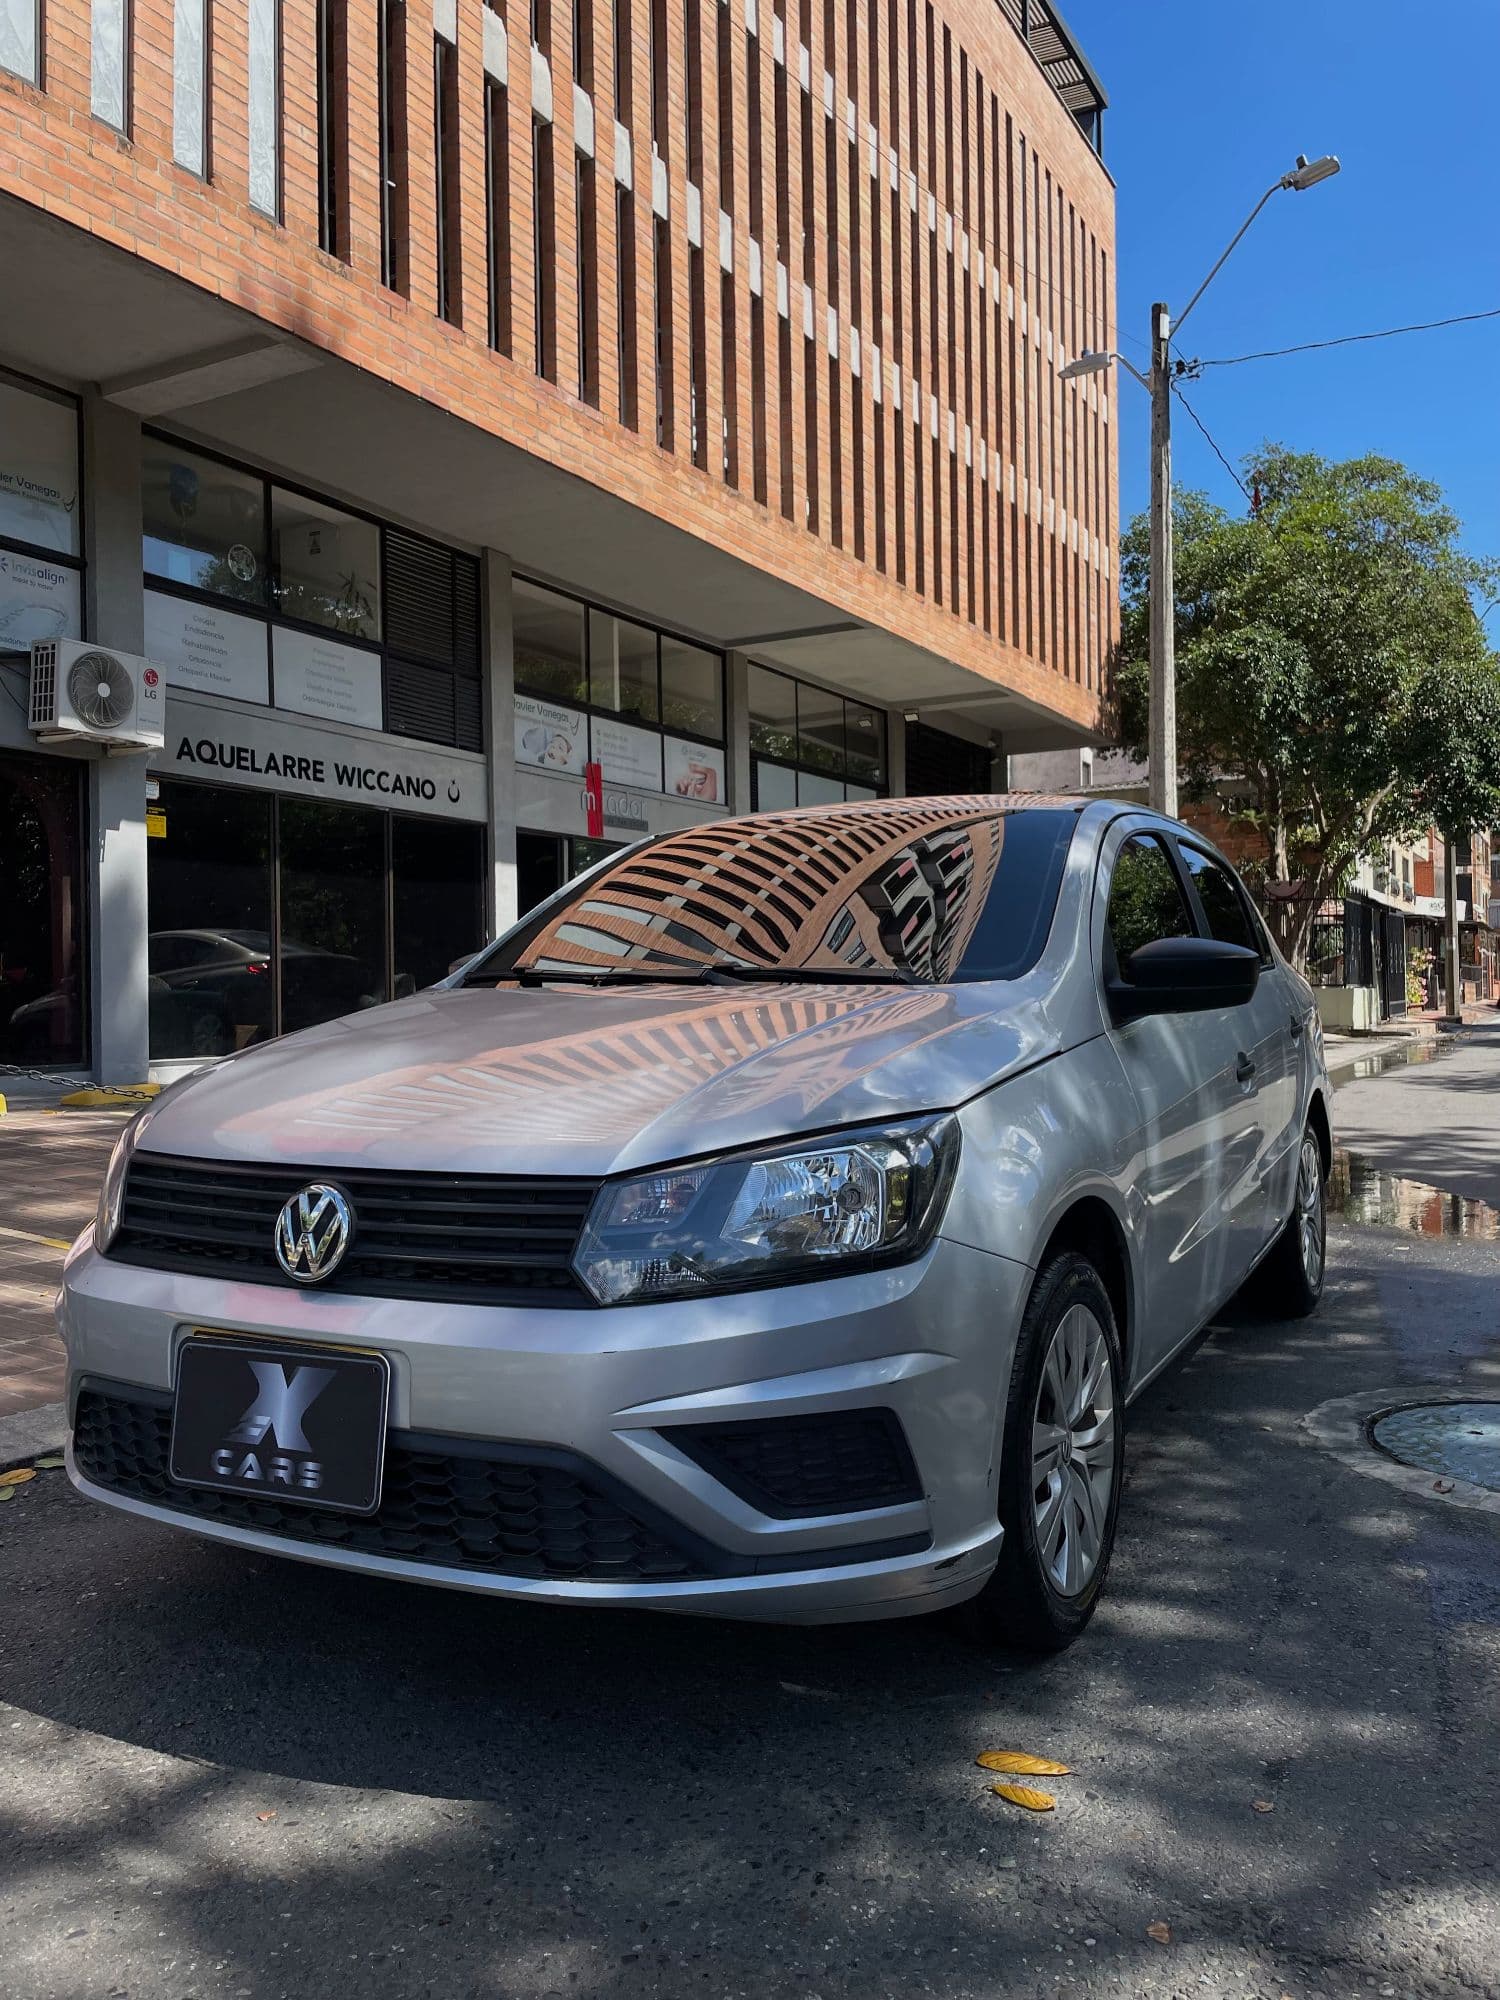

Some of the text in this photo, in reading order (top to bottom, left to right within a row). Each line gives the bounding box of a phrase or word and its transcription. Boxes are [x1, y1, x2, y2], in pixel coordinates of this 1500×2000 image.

[12, 561, 65, 585] invisalign
[145, 689, 157, 700] LG
[176, 737, 436, 800] AQUELARRE WICCANO
[211, 1448, 323, 1489] CARS
